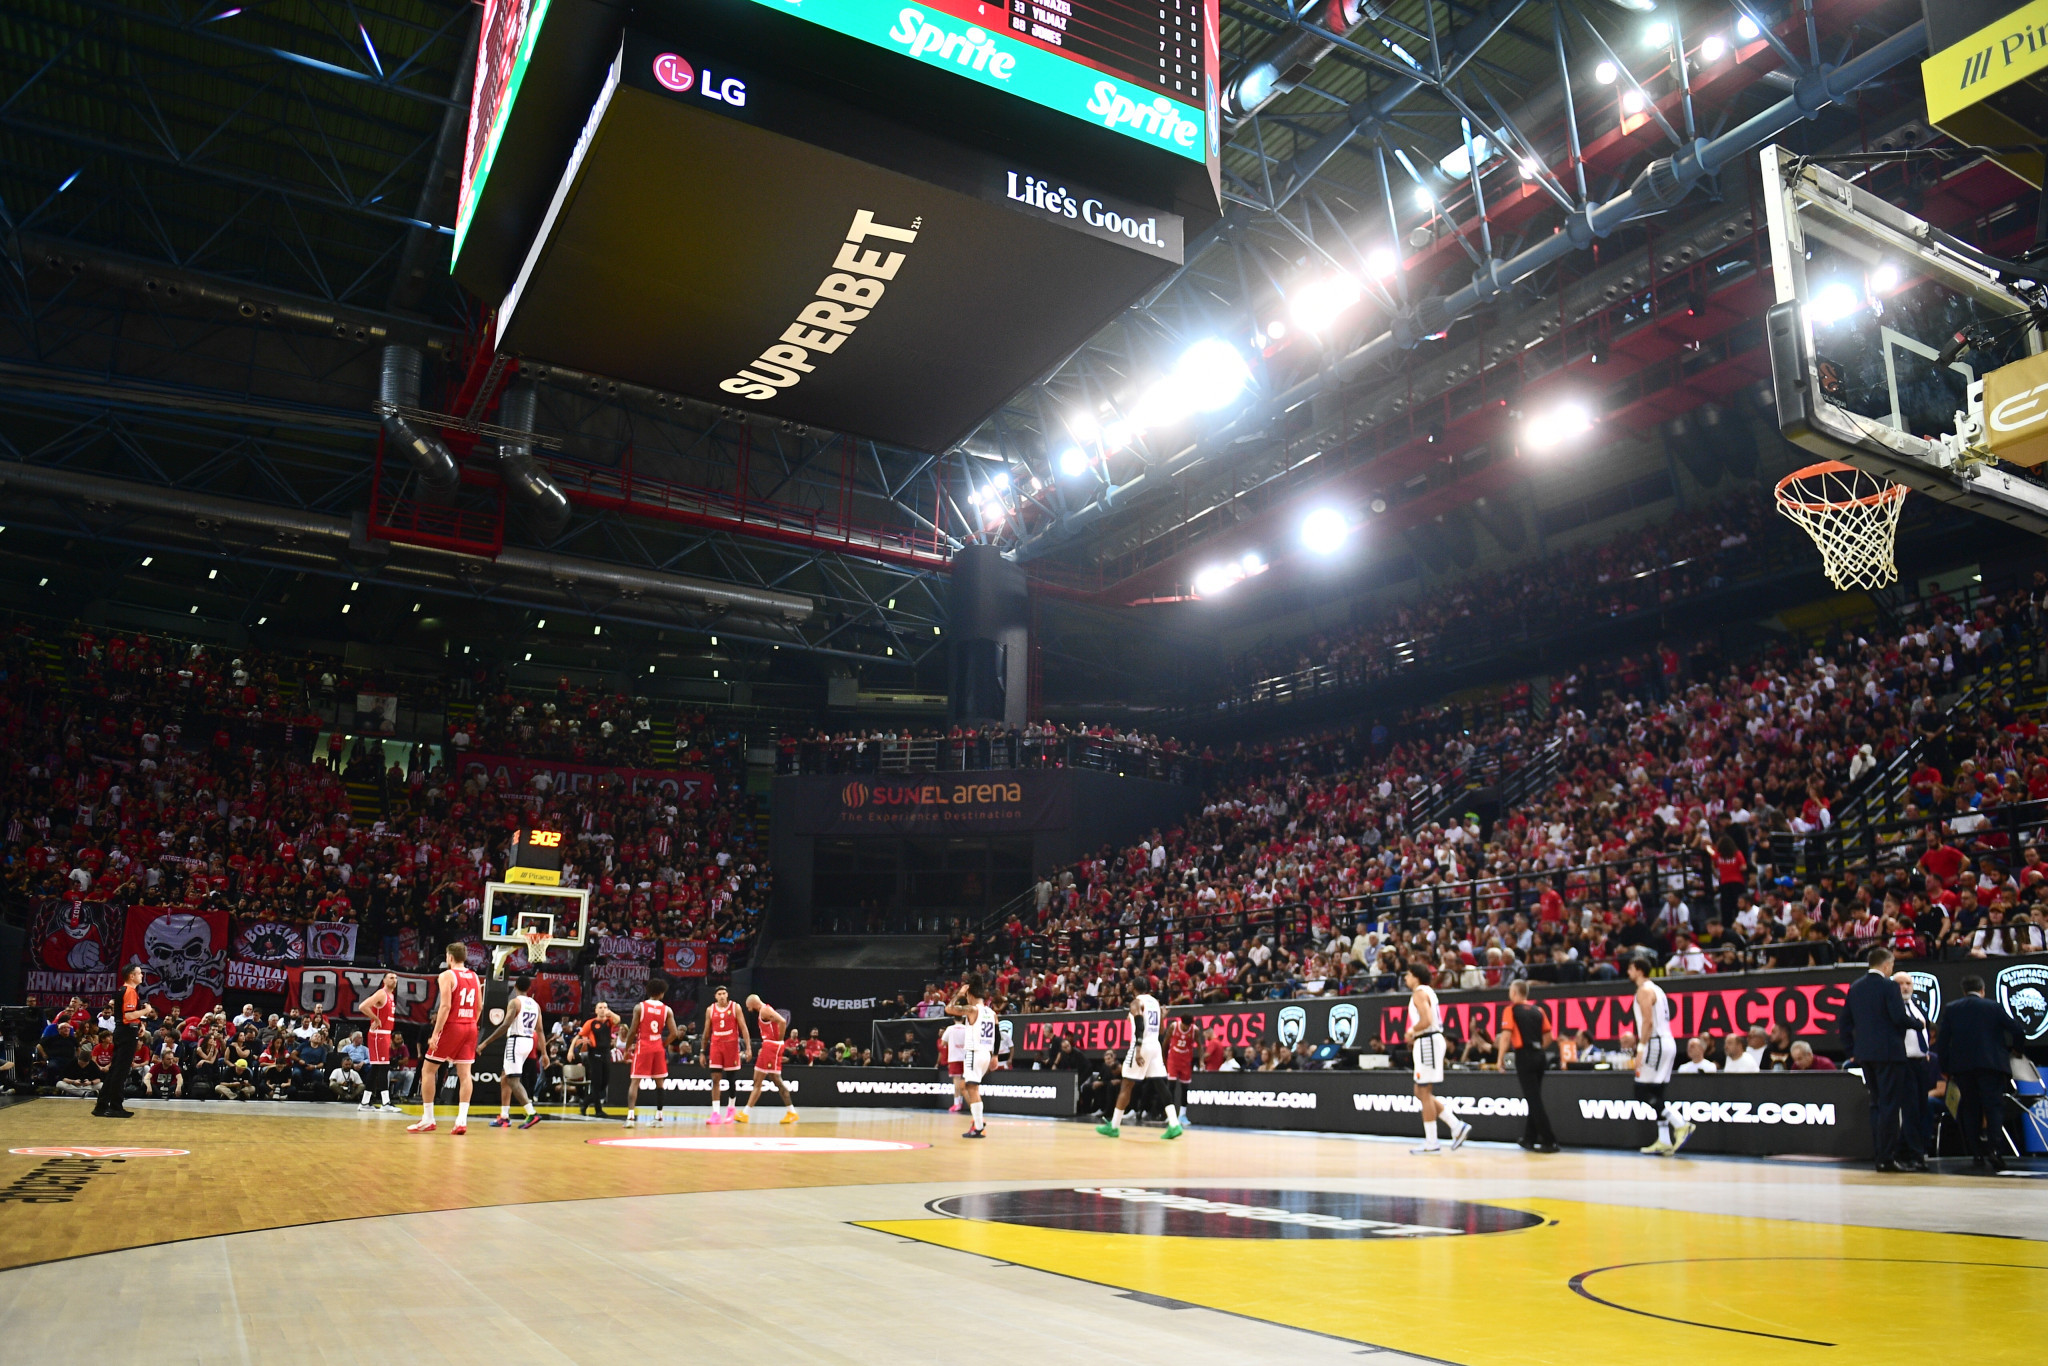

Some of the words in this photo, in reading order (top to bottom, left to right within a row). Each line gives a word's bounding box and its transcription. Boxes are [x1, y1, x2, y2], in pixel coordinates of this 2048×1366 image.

[1032, 6, 1067, 31] YILMAZ
[1012, 16, 1026, 32] 88
[1032, 24, 1062, 46] JONES
[889, 8, 1016, 80] Sprite
[701, 69, 746, 107] LG
[1086, 80, 1198, 147] Sprite
[1007, 170, 1078, 220] Life's
[1082, 198, 1166, 248] Good.
[719, 209, 918, 400] SUPERBET
[872, 786, 949, 805] SUNEL
[953, 783, 1022, 804] arena
[841, 812, 863, 821] The
[868, 811, 939, 822] Experience
[944, 810, 1022, 820] Destination
[528, 872, 554, 881] Piraeus
[26, 970, 117, 992] KAMATERO
[459, 988, 476, 1007] 14
[812, 996, 876, 1010] SUPERBET
[523, 1012, 536, 1028] 22
[720, 1020, 725, 1028] 3
[1148, 1010, 1158, 1026] 20
[980, 1021, 994, 1038] 32
[1563, 1044, 1572, 1060] 5
[1187, 1090, 1317, 1110] WWW.KICKZ.COM
